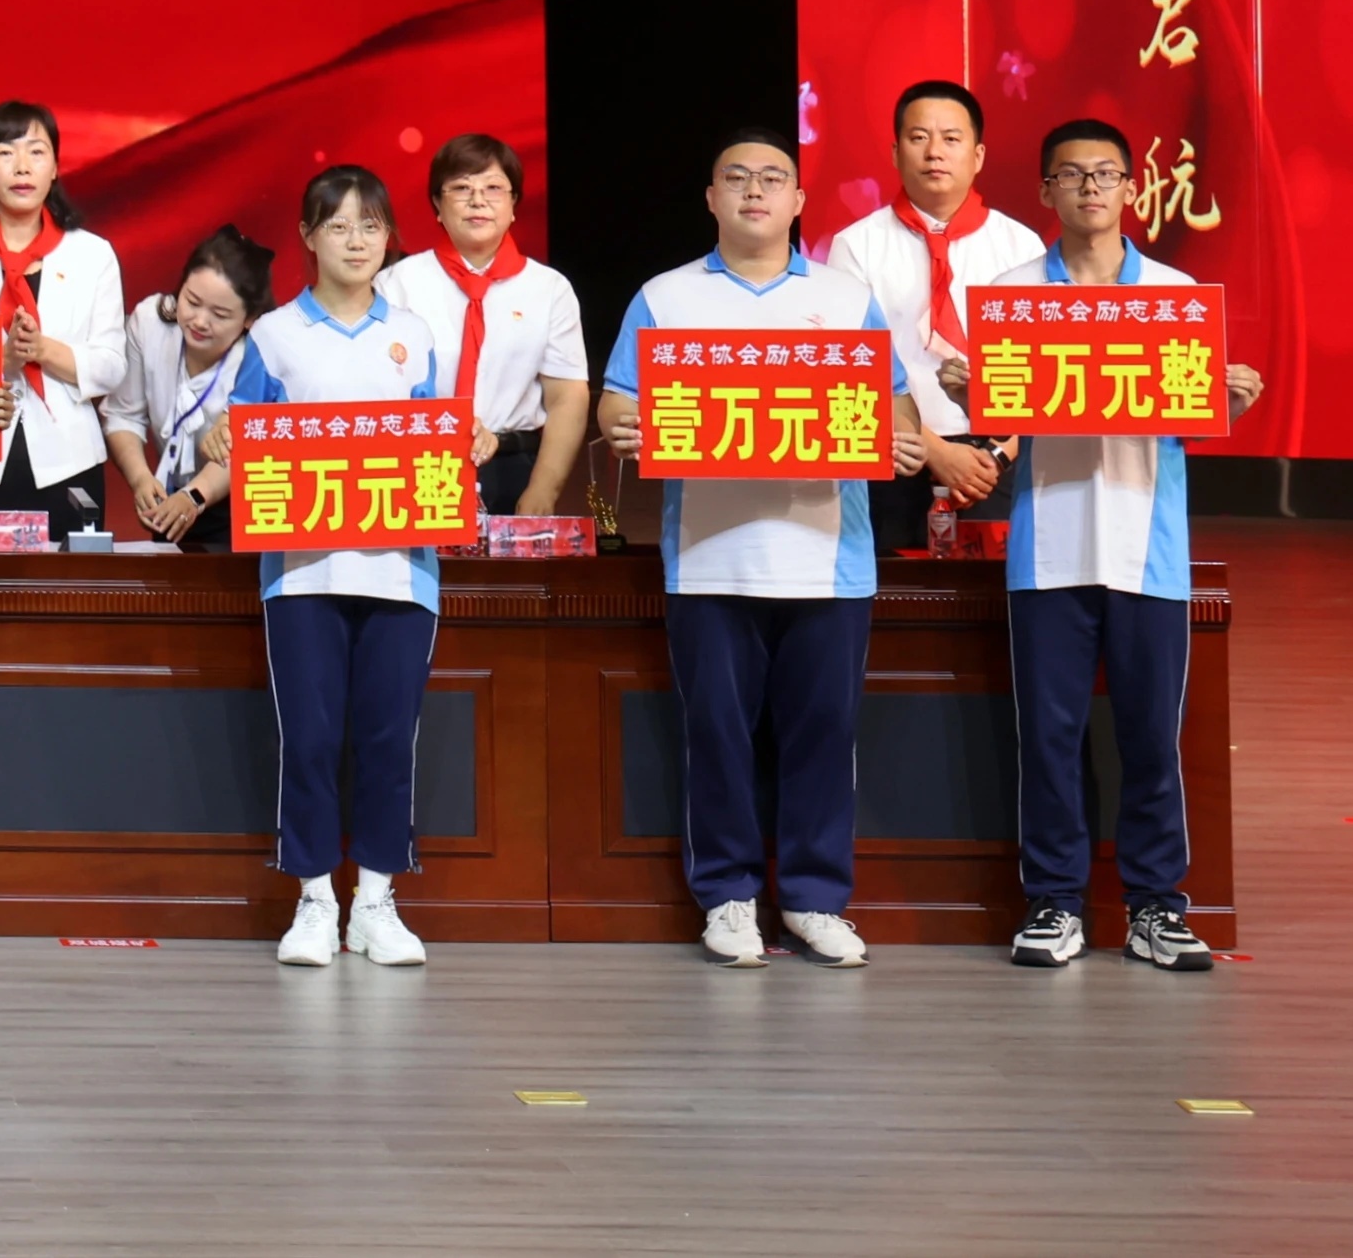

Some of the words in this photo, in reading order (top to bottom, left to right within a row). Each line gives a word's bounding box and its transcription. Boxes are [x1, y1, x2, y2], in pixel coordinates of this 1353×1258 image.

[980, 298, 1209, 324] 煤炭协会励志基金
[651, 341, 877, 367] 煤炭协会励志基金
[981, 338, 1214, 419] 壹万元整
[243, 411, 460, 442] 煤炭协会励志基金
[651, 381, 880, 463] 壹万元整
[243, 450, 465, 534] 壹万元整
